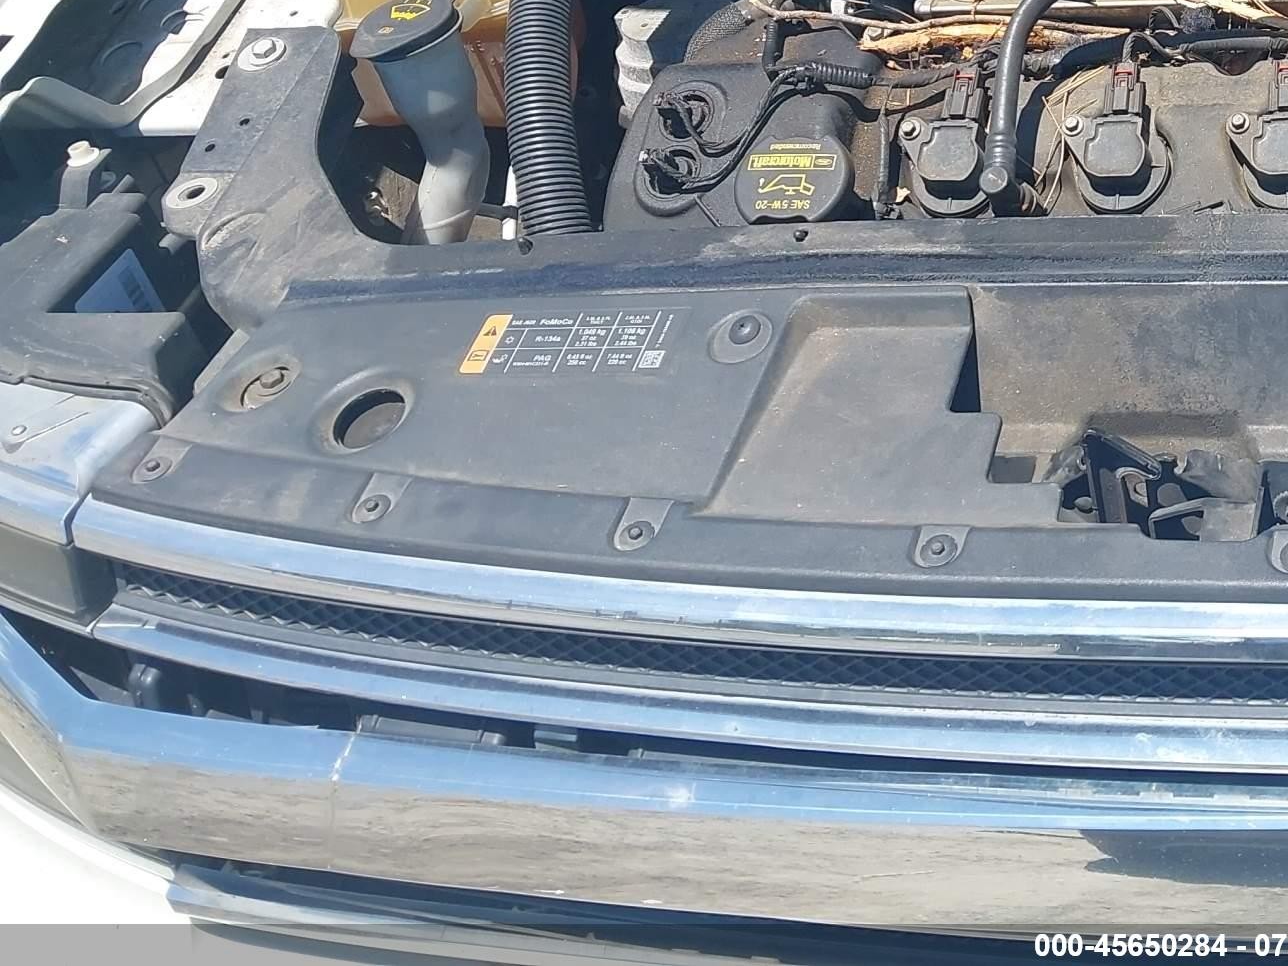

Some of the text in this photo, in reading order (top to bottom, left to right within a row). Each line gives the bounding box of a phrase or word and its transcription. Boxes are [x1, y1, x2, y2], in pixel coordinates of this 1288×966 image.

[769, 143, 822, 151] Recommended
[752, 156, 812, 168] Motorcraft
[755, 200, 811, 210] SAE 5W-20
[533, 354, 552, 362] PAG
